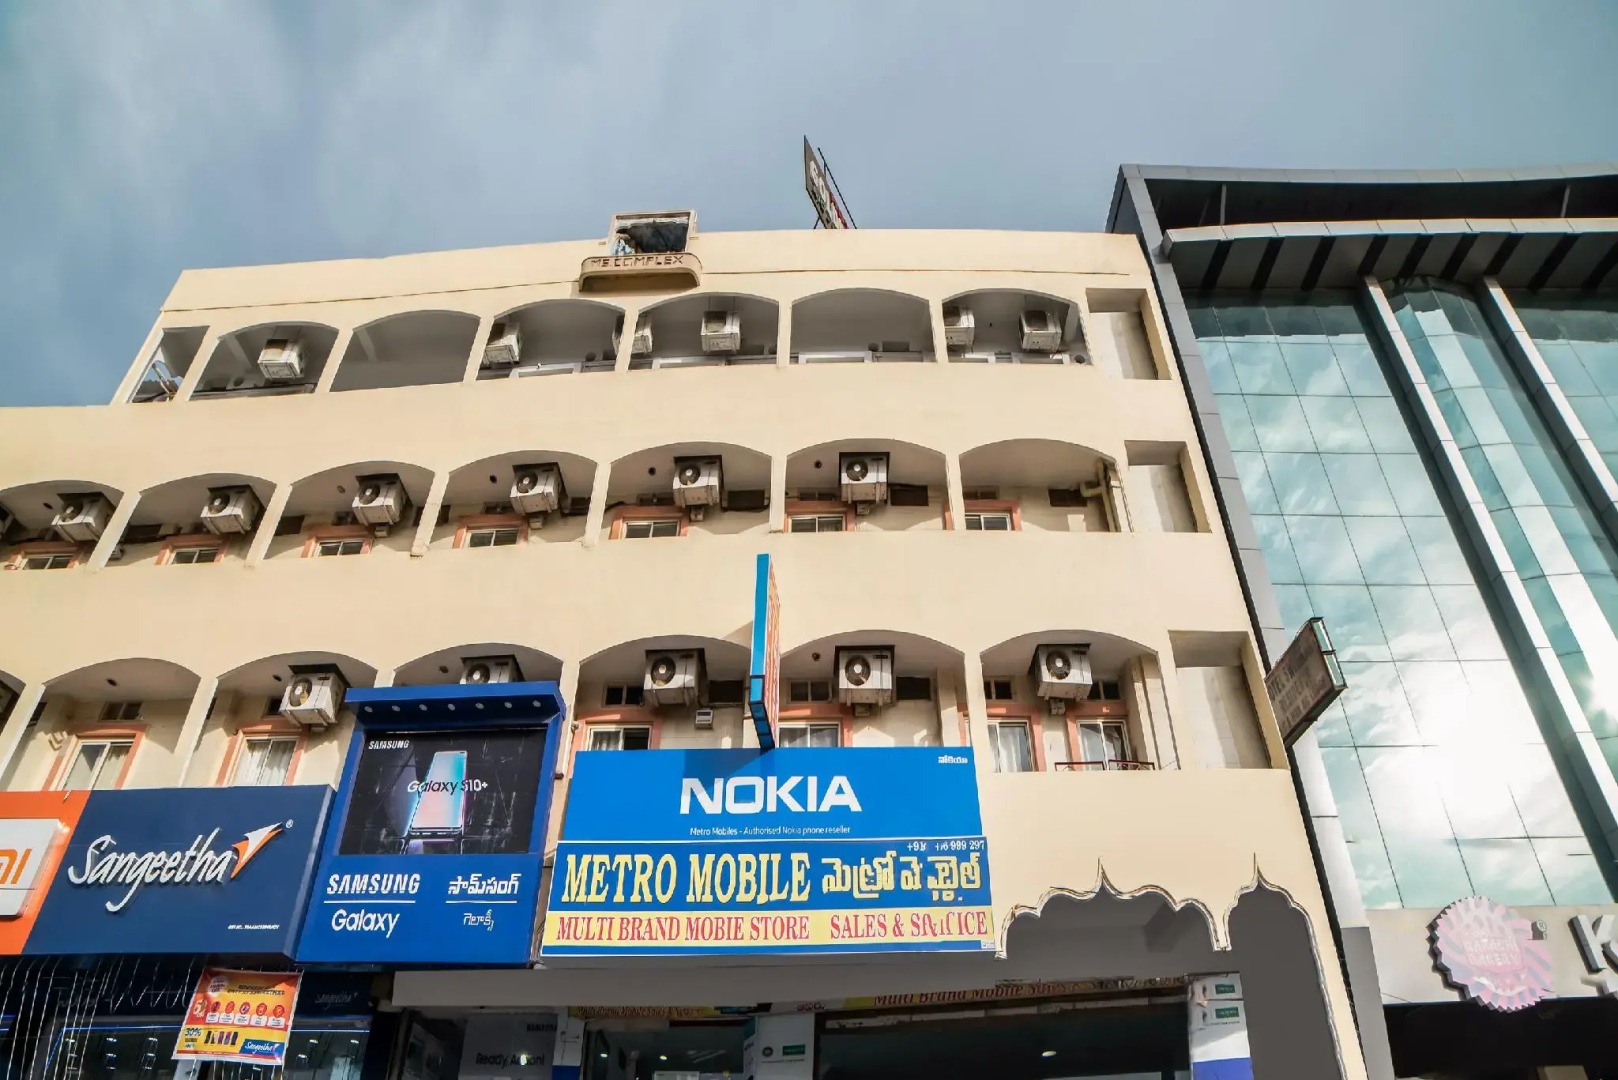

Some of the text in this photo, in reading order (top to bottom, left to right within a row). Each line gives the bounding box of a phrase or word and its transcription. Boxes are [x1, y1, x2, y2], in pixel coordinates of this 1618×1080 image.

[368, 739, 410, 750] SAMSUNG
[407, 779, 489, 796] Galaxy S10+
[680, 775, 863, 815] NOKIA
[689, 826, 711, 836] Metro
[712, 826, 738, 835] Mobiles
[743, 825, 781, 835] Authorised
[825, 824, 851, 834] reseller
[67, 827, 237, 913] Sangeetha
[327, 873, 421, 894] SAMSUNG
[561, 852, 812, 905] METRO MOBILE
[331, 908, 400, 939] Galaxy
[556, 916, 613, 940] MULTI
[617, 916, 680, 940] BRAND
[685, 916, 744, 940] MOBIE
[750, 915, 810, 940] STORE
[830, 913, 887, 939] SALES
[892, 913, 905, 938] &
